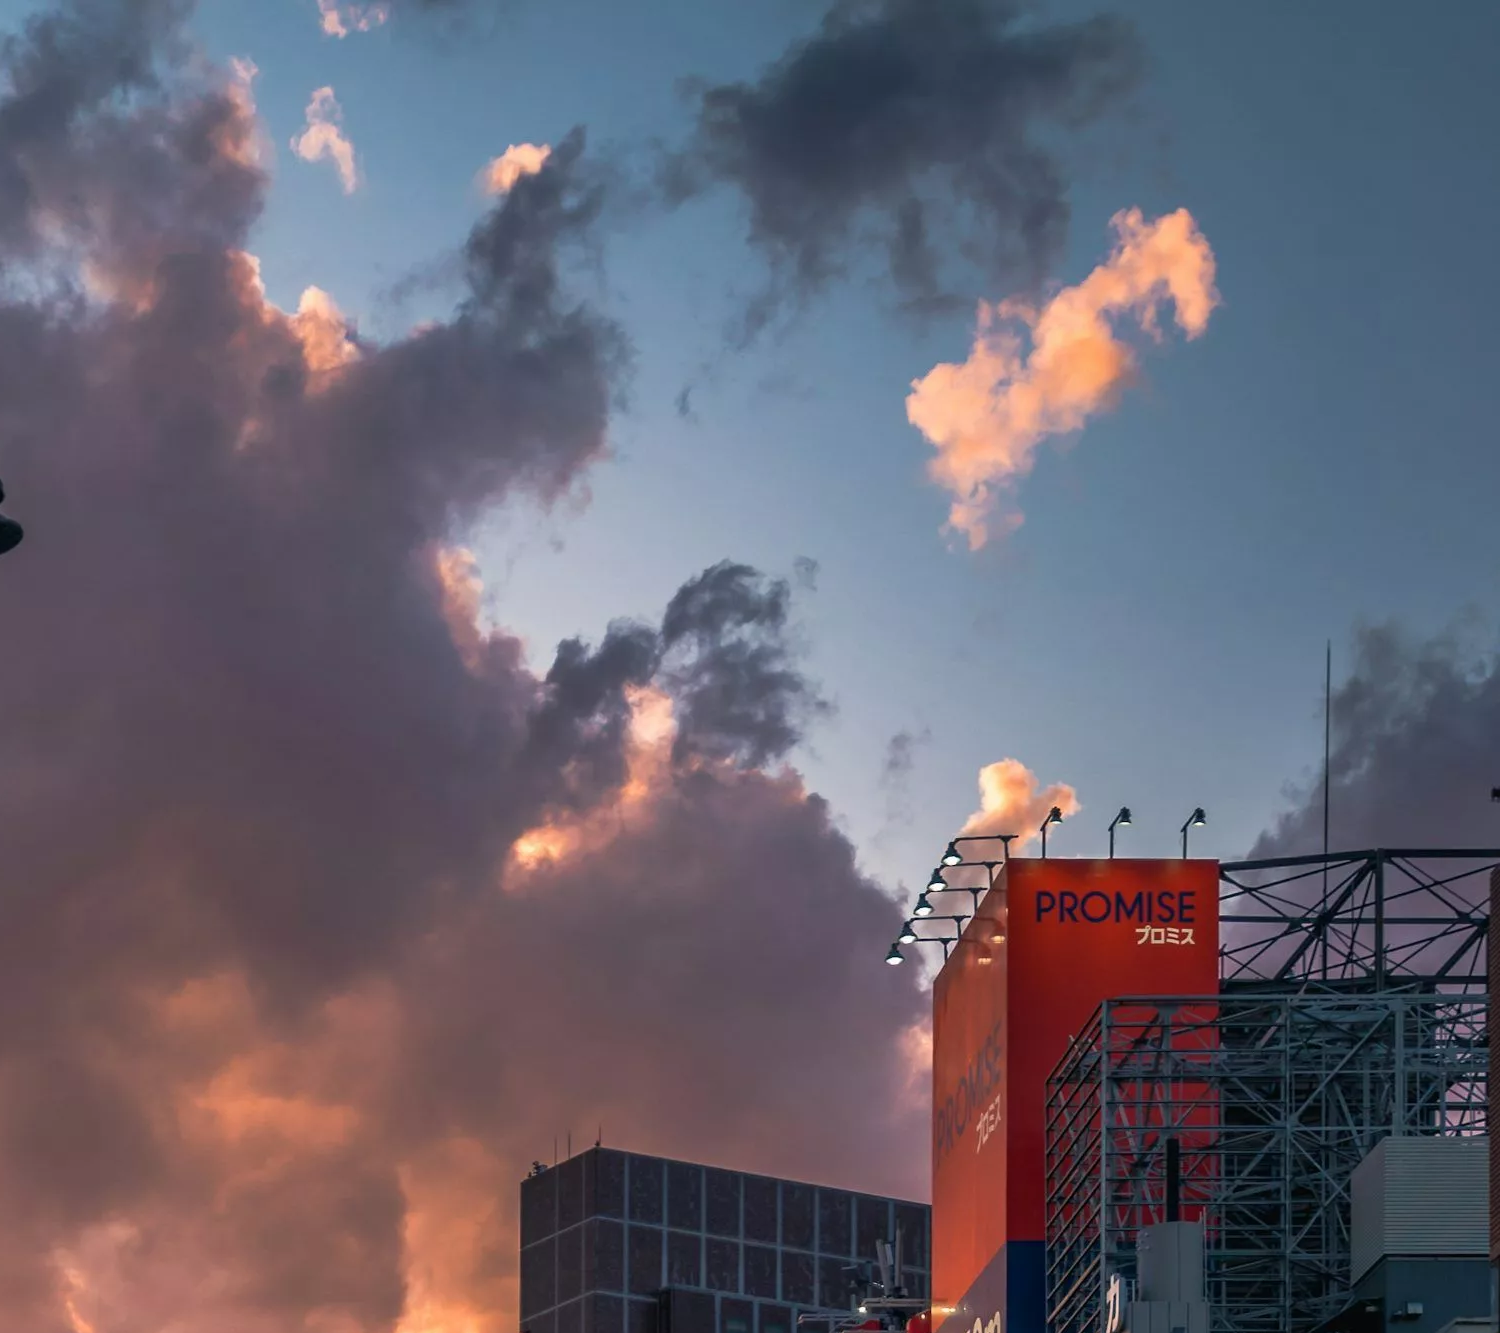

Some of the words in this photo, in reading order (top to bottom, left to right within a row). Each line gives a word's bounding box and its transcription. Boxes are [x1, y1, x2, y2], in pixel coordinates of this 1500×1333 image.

[1035, 890, 1196, 924] PROMISE
[1135, 924, 1196, 945] プロミス
